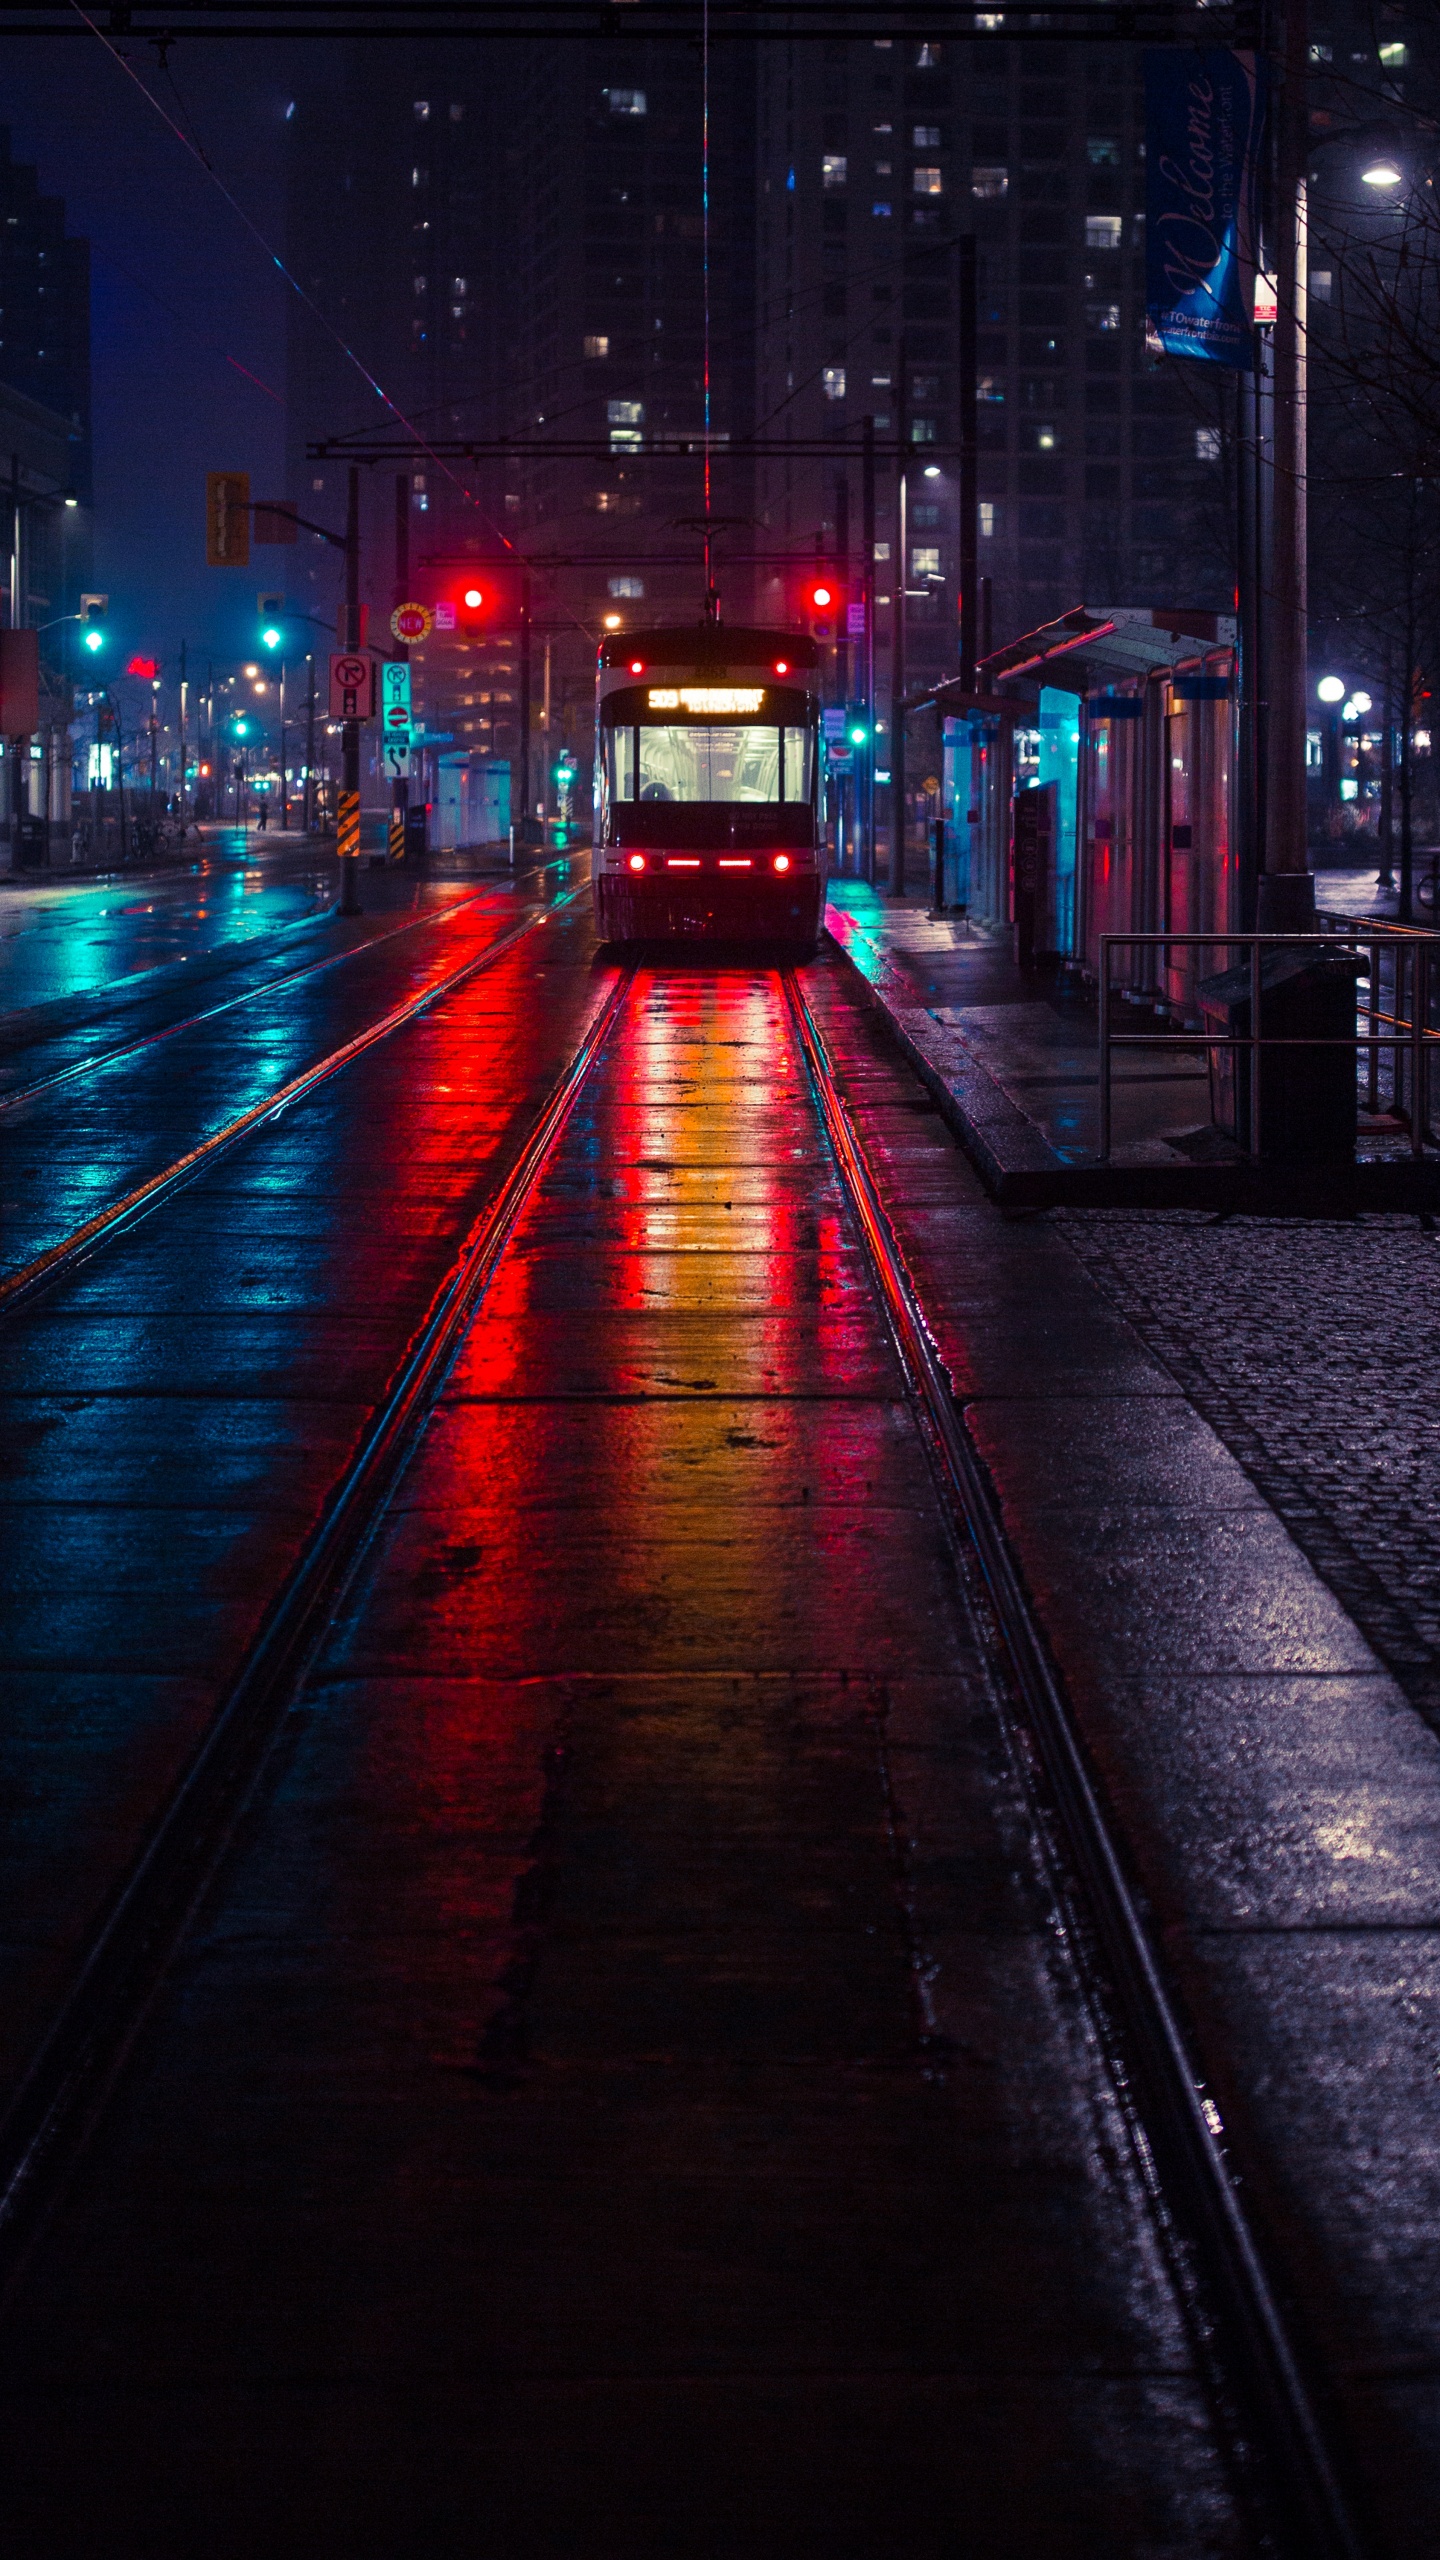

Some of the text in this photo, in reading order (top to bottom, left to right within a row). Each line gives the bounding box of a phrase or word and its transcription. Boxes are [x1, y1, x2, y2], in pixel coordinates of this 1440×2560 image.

[1156, 73, 1221, 296] Welcome
[1218, 84, 1234, 219] to the Waterfront
[398, 617, 423, 630] NEW
